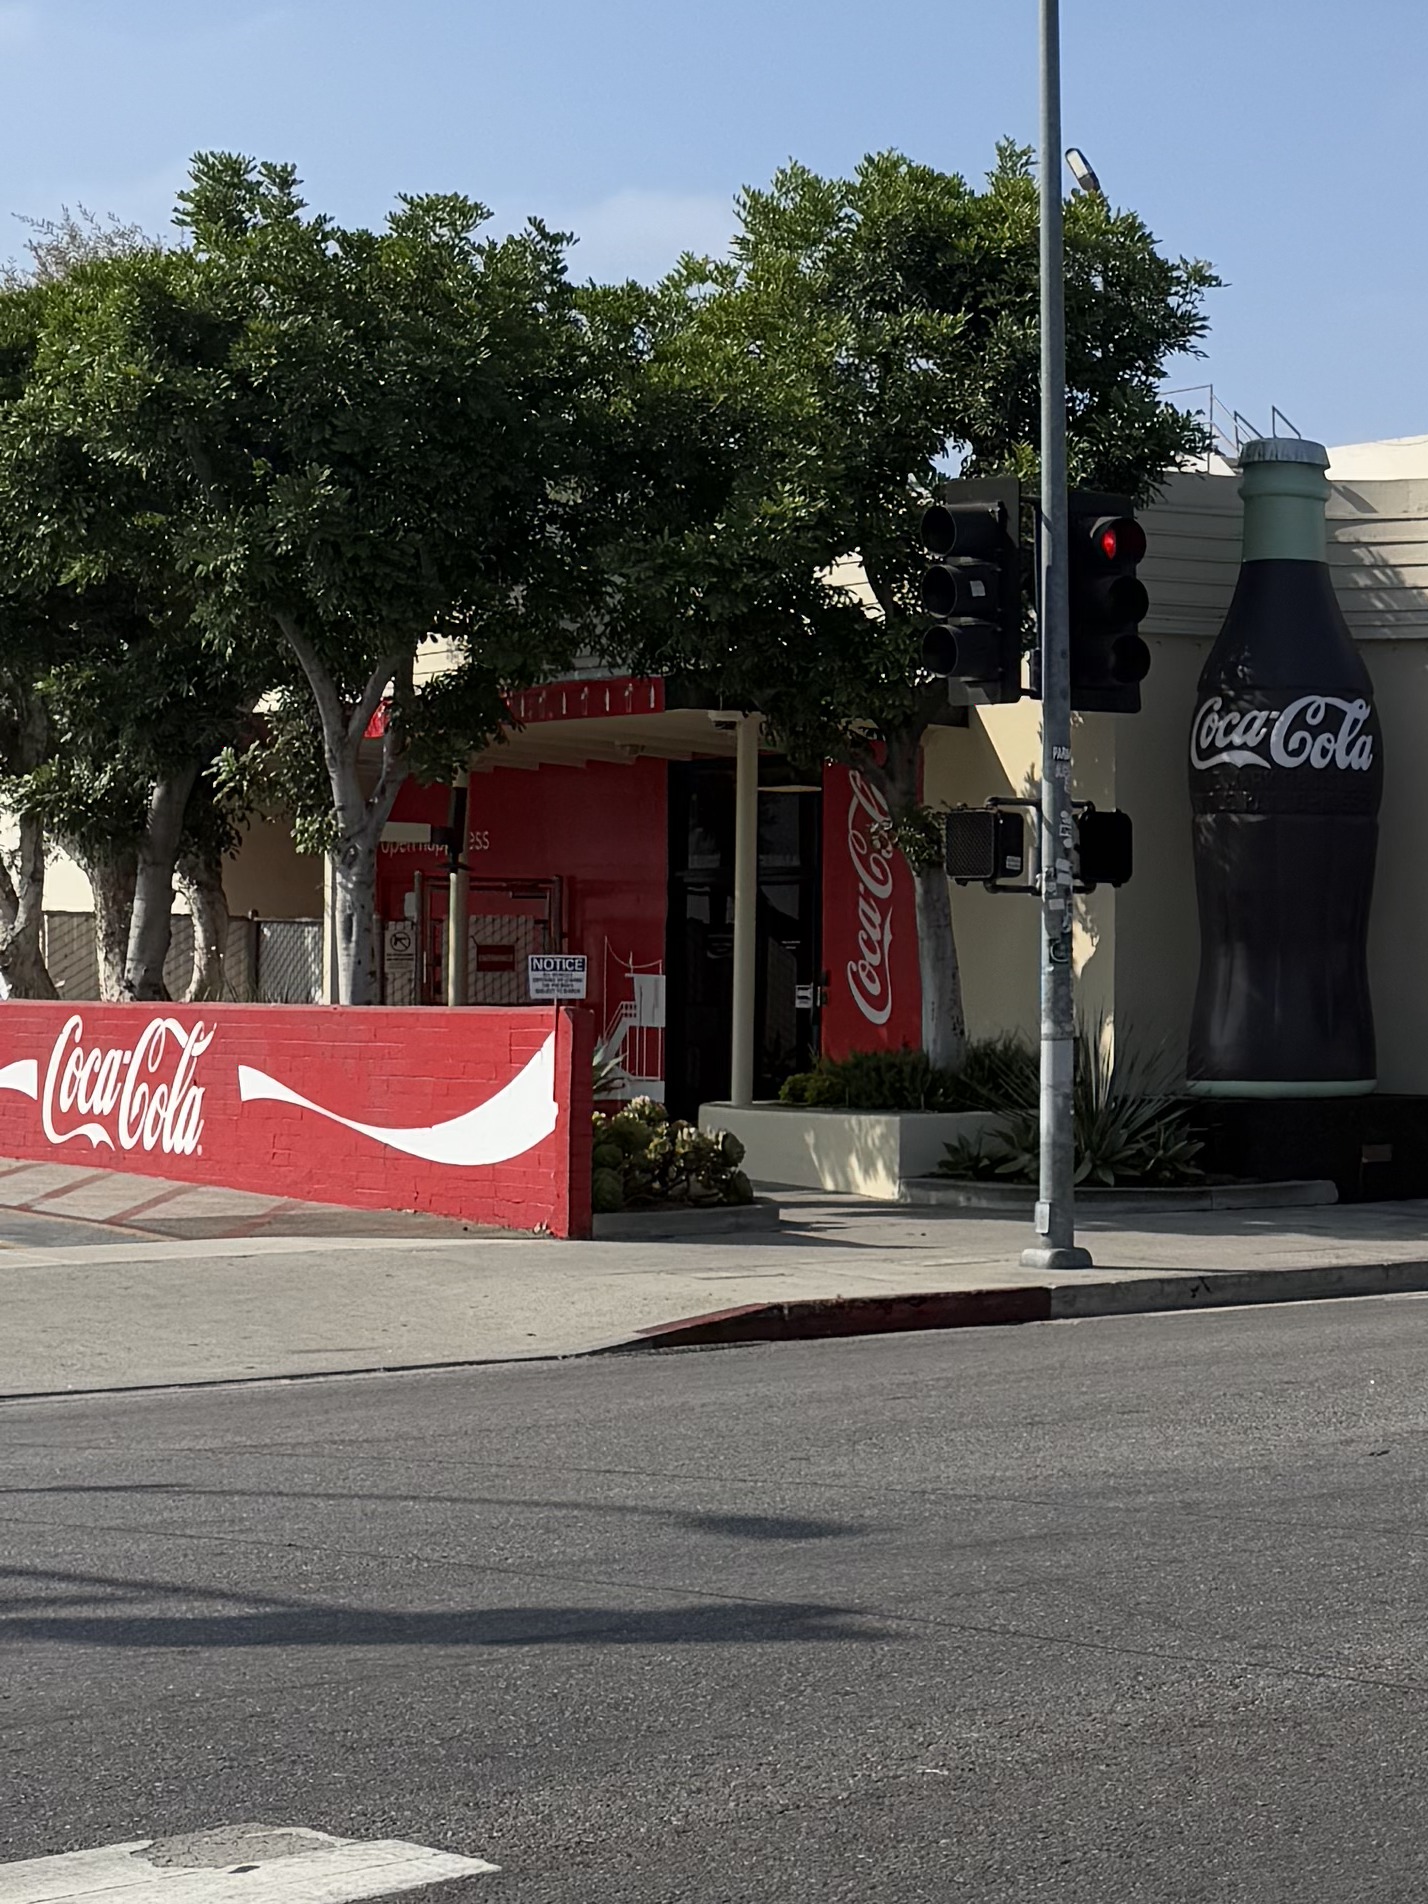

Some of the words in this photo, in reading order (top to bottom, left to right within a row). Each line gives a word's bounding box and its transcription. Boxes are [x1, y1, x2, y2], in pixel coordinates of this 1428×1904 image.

[1191, 695, 1374, 771] Coca-Cola
[532, 958, 584, 971] NOTICE
[42, 1014, 217, 1156] Coca-Cola
